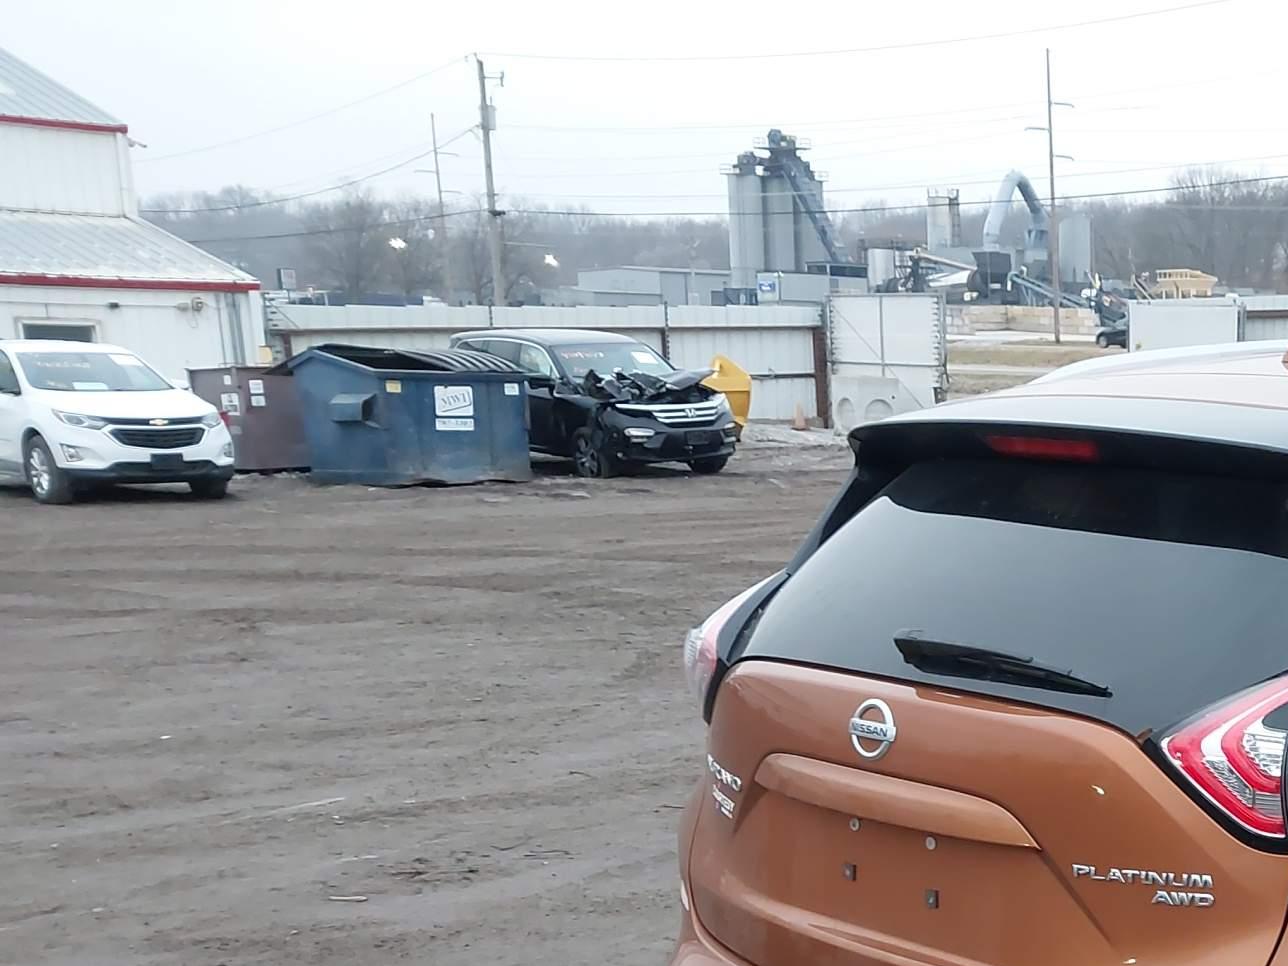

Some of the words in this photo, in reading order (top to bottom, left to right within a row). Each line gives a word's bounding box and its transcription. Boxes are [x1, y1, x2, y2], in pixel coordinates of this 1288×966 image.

[852, 721, 888, 738] NISSAN
[1072, 863, 1213, 888] PLATINUM
[1151, 890, 1215, 907] AWD
